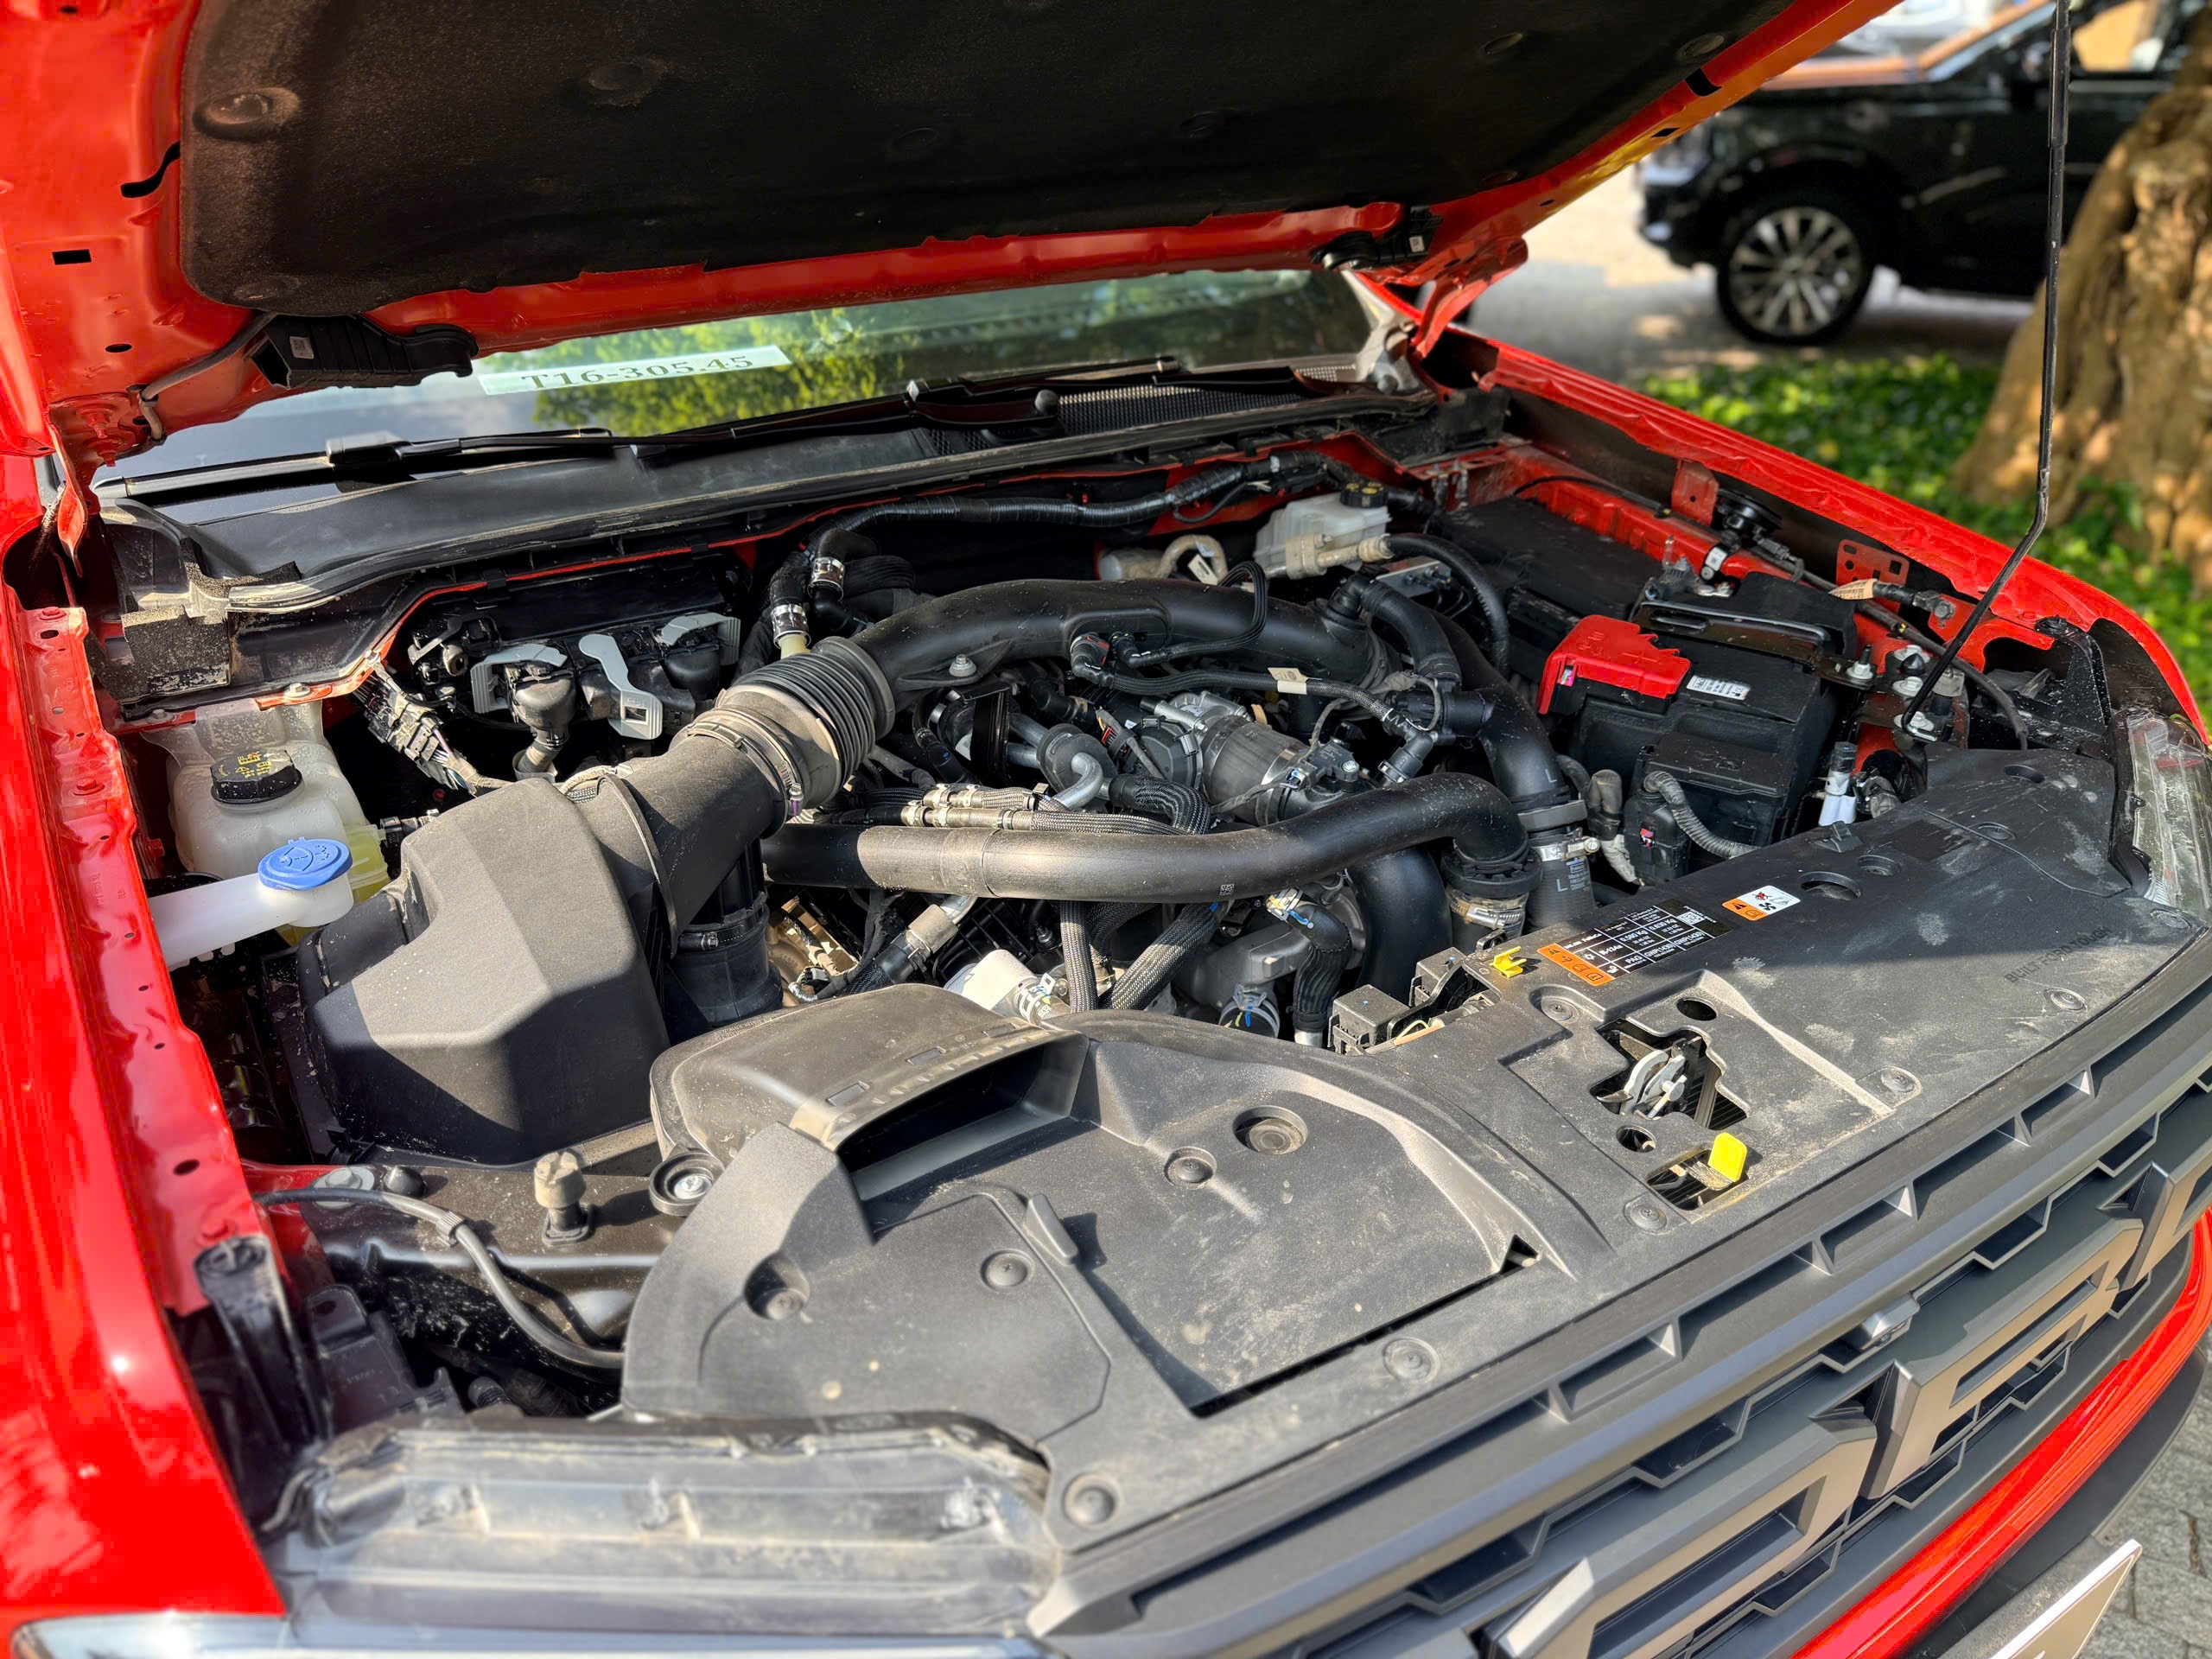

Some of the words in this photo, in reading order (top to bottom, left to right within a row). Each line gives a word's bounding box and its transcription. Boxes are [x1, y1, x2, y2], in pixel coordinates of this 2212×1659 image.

[521, 355, 753, 388] T16-305.45
[1556, 879, 1568, 892] L
[2004, 961, 2039, 983] BUILT
[2038, 945, 2073, 966] FORD
[2069, 925, 2112, 950] TOUGH
